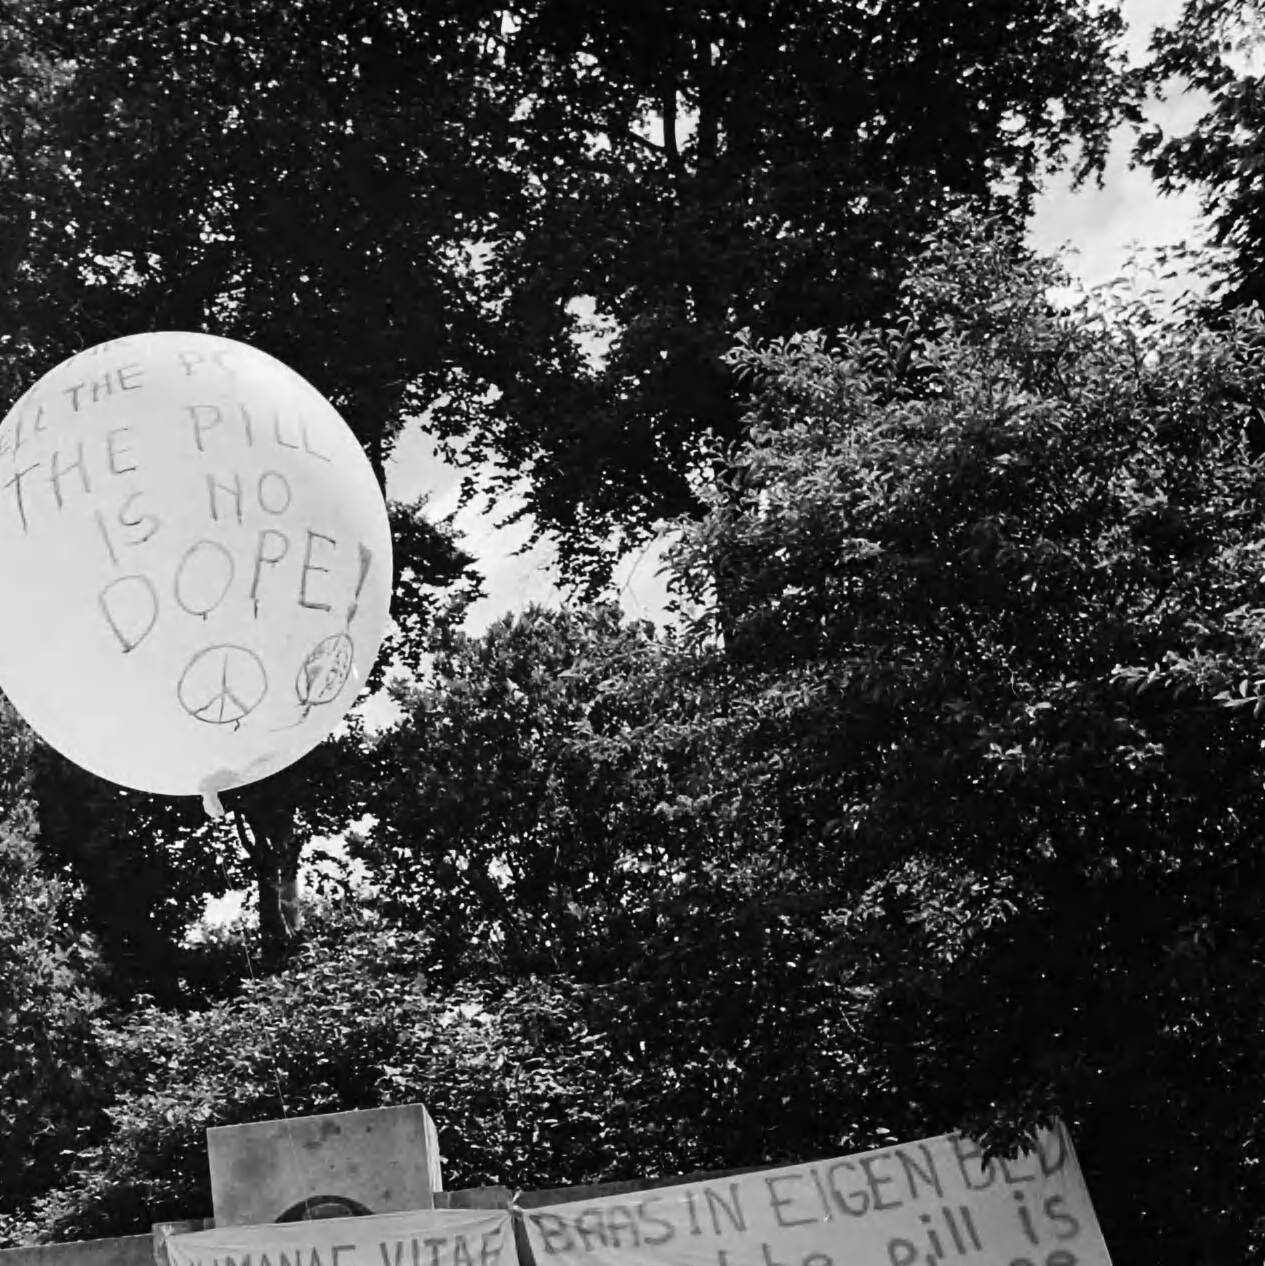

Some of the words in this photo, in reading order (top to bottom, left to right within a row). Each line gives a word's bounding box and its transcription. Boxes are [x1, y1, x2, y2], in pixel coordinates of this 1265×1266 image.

[64, 363, 143, 412] THE
[3, 427, 138, 533] THE
[187, 403, 332, 463] PILL
[96, 491, 159, 567] IS
[206, 470, 292, 525] NO
[98, 528, 373, 654] DOPE!
[530, 1197, 675, 1254] BAAS
[686, 1183, 746, 1236] IN
[765, 1143, 944, 1228] EIGEN
[1013, 1189, 1080, 1245] is
